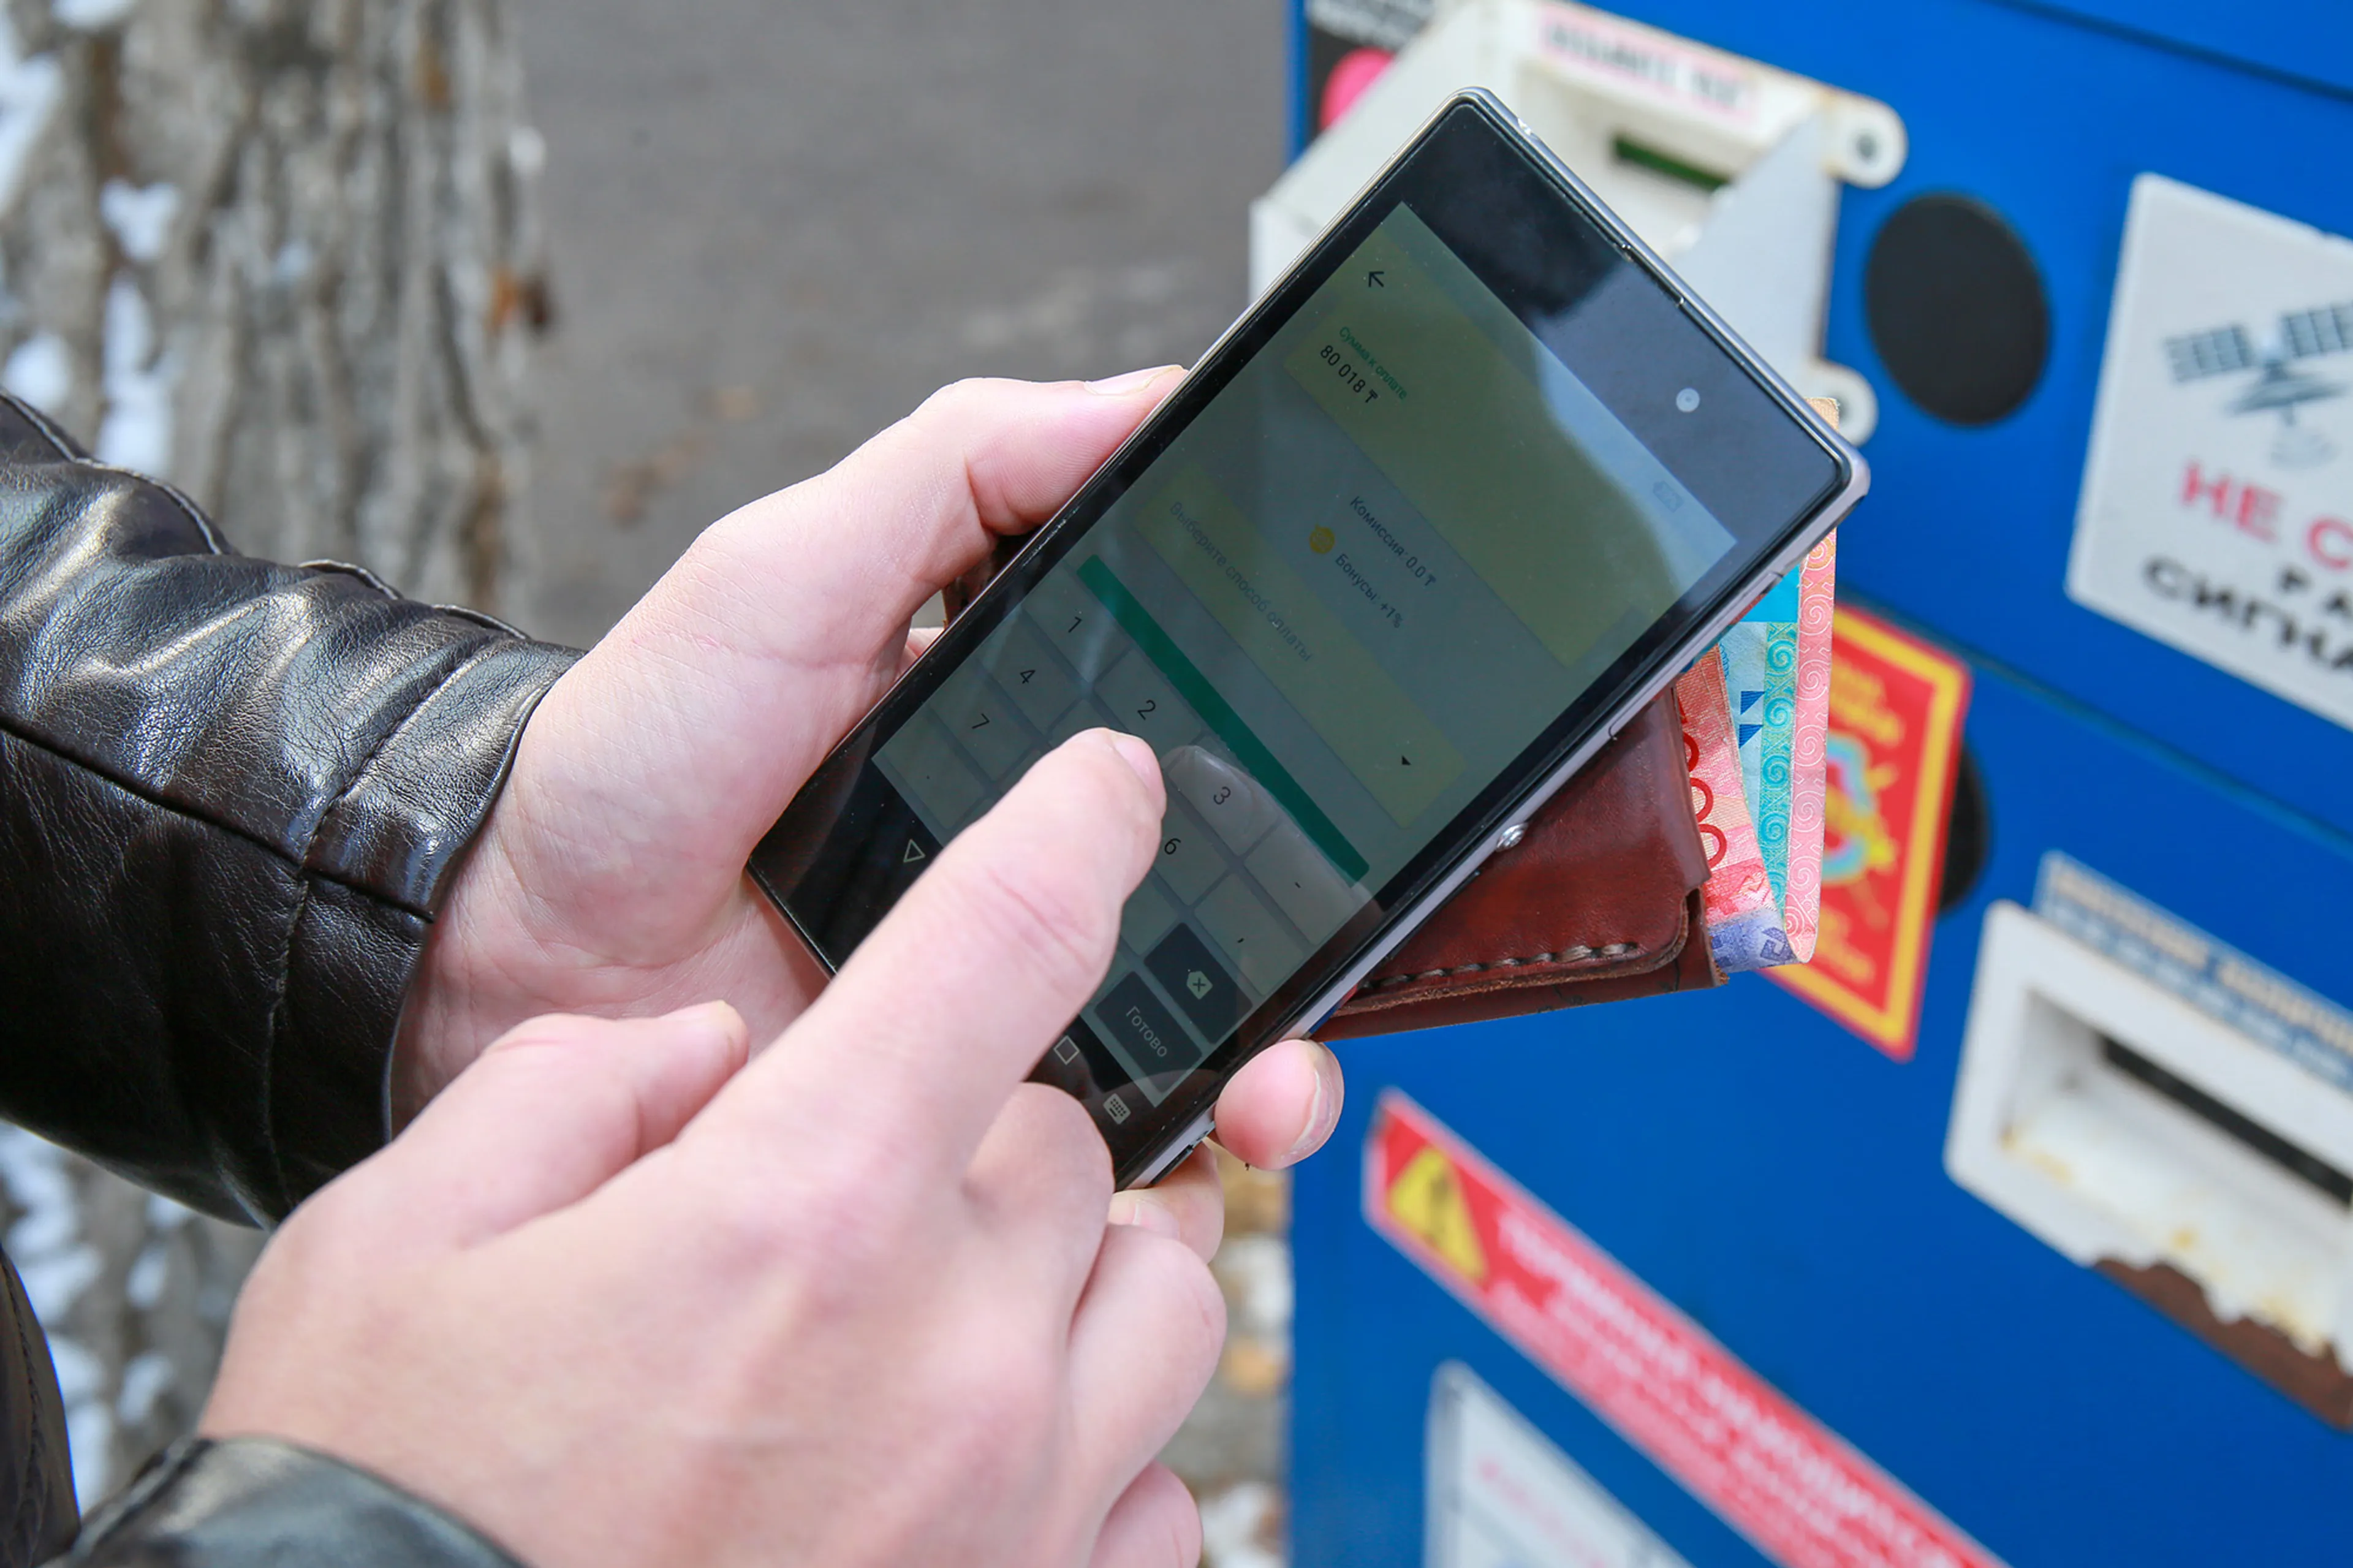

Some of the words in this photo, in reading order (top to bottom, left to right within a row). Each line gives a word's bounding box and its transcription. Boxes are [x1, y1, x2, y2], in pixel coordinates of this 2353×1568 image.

[1320, 345, 1341, 366] 80
[1338, 363, 1366, 393] 018
[1339, 326, 1370, 360] Сумма
[1368, 357, 1377, 367] к
[1375, 365, 1408, 400] оплате
[2180, 458, 2284, 543] НЕ
[1406, 556, 1427, 578] 0.0
[1170, 501, 1227, 566] Выберите
[1226, 566, 1271, 612] способ
[1267, 612, 1313, 662] оплаты
[1067, 616, 1083, 634] 1
[1380, 602, 1404, 629] +1%
[1020, 668, 1036, 684] 4
[1137, 699, 1156, 721] 2
[972, 713, 990, 730] 7
[1213, 786, 1232, 805] 3
[1164, 838, 1181, 855] 6
[1126, 1006, 1167, 1058] Готово
